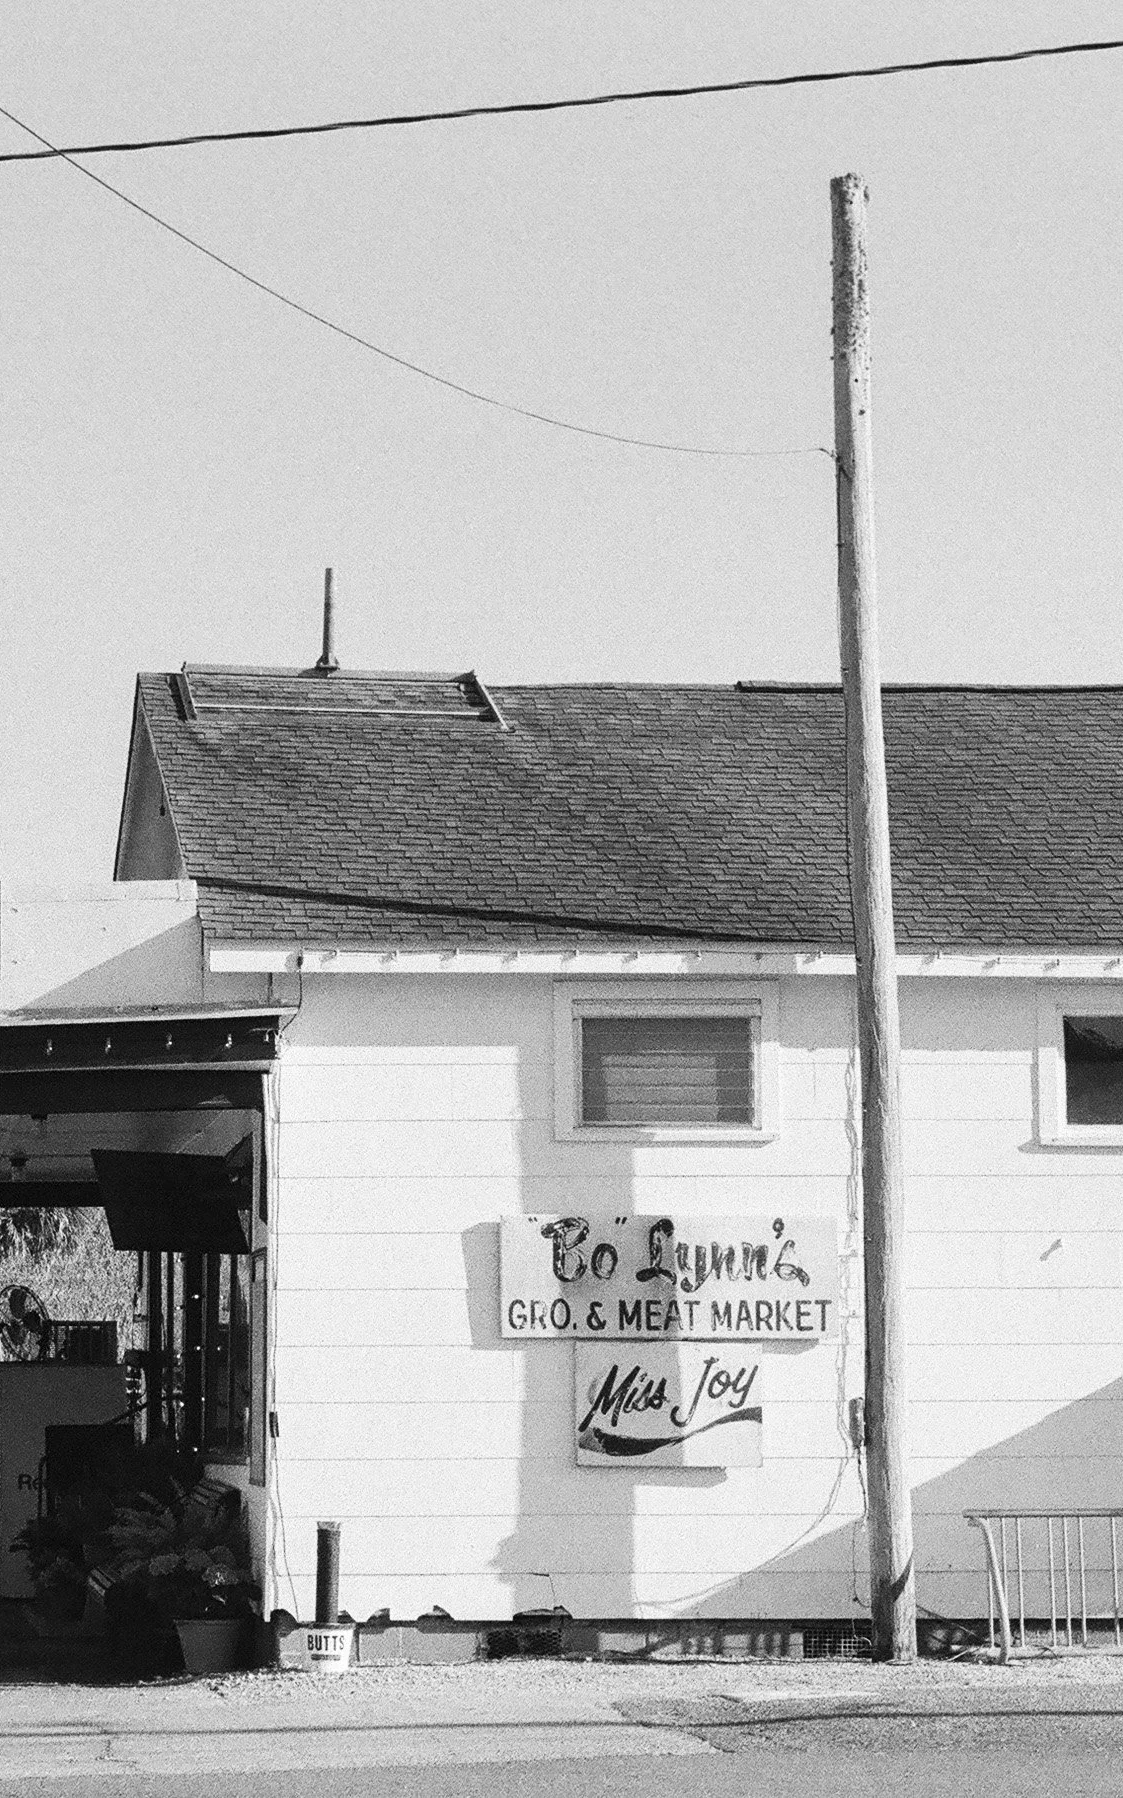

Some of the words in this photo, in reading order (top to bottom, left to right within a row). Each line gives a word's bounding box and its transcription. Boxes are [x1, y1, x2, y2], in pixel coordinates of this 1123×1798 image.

[635, 1218, 811, 1293] Lynn's
[508, 1299, 577, 1331] GRO.
[586, 1301, 607, 1331] &
[618, 1299, 700, 1331] MEAT
[710, 1299, 832, 1332] MARKET
[578, 1364, 668, 1432] Miss
[670, 1356, 759, 1428] Joy
[307, 1634, 345, 1651] BUTTS
